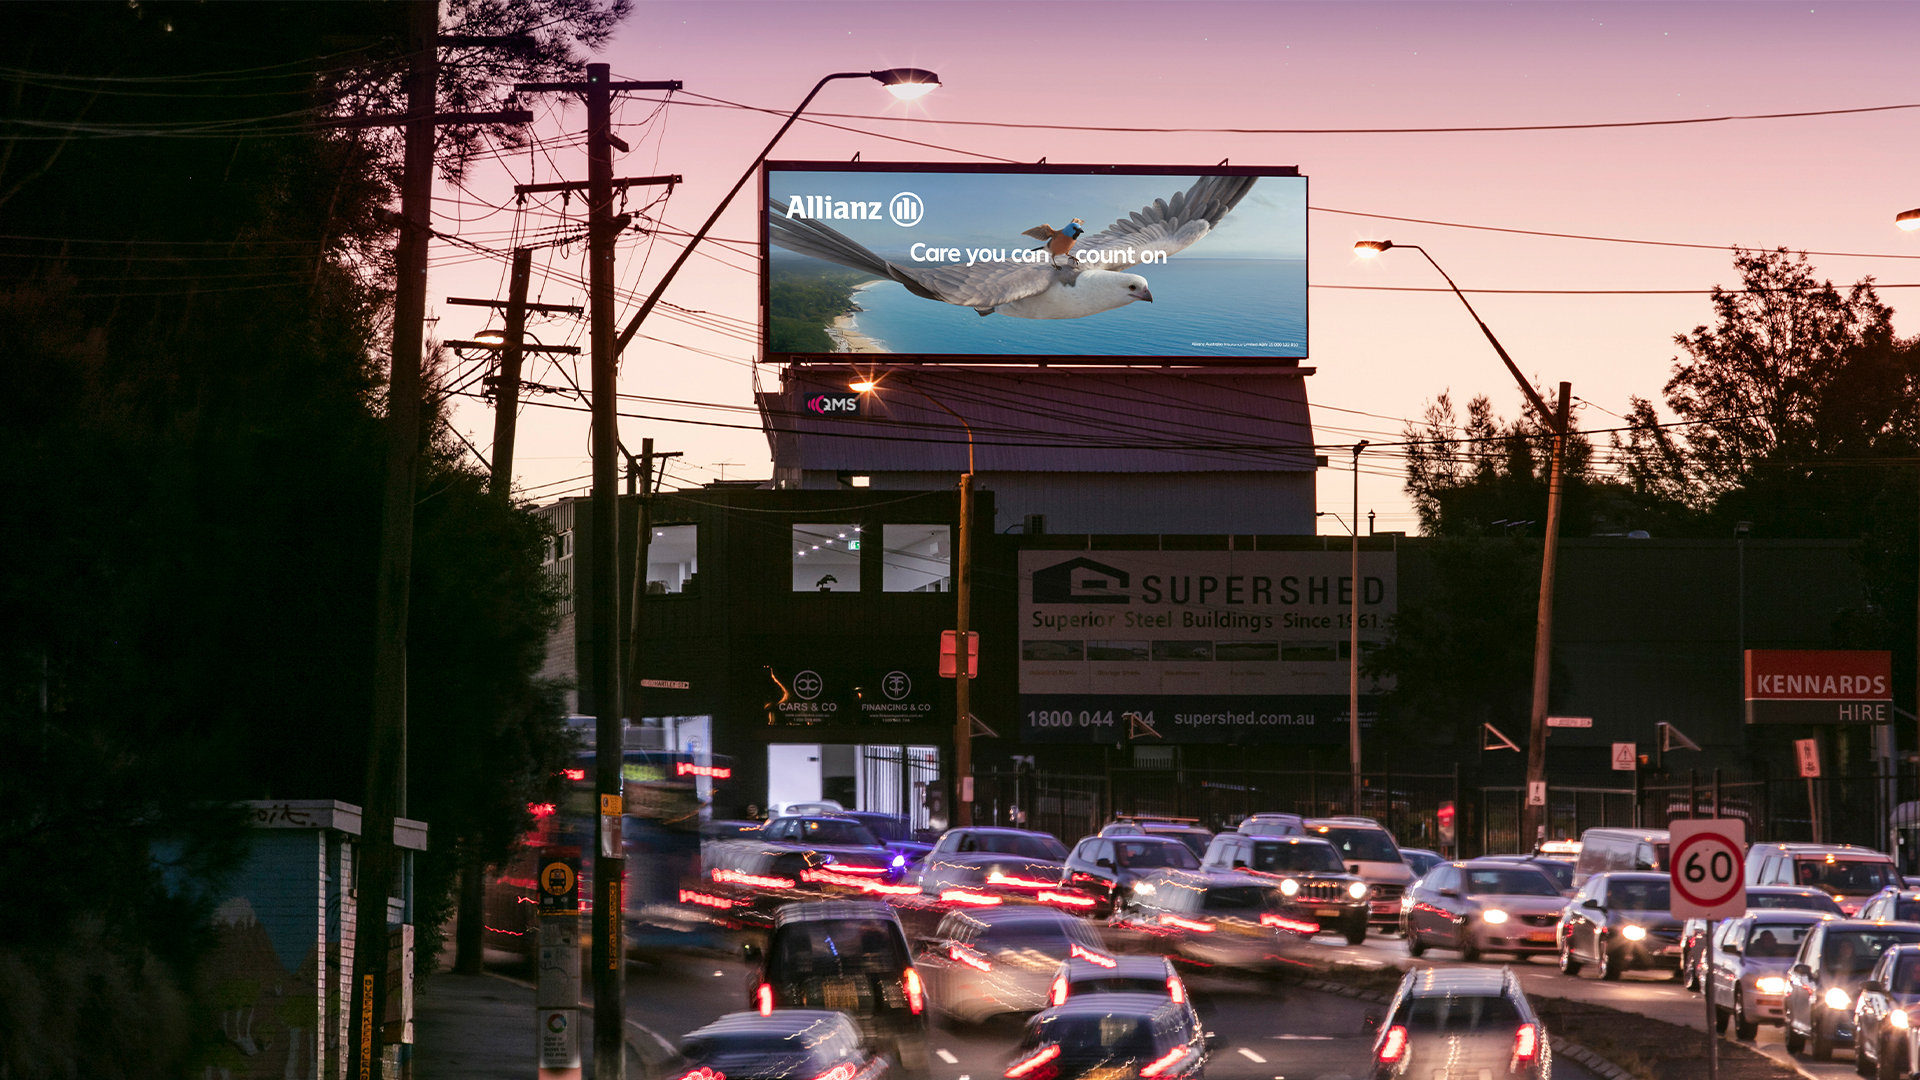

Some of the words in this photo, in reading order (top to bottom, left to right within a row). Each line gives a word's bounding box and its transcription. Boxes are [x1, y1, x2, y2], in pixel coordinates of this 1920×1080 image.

[785, 195, 883, 219] Allianz
[910, 243, 961, 263] Care
[964, 248, 1012, 267] you
[1016, 248, 1050, 263] can
[1075, 246, 1136, 264] count
[1140, 249, 1167, 264] on
[814, 395, 857, 414] QMS
[1141, 575, 1385, 605] SUPERSHED
[1032, 611, 1115, 632] Superior
[1123, 611, 1172, 628] Steel
[1183, 611, 1273, 633] Buildings
[1283, 612, 1331, 628] Since
[1757, 674, 1886, 694] KENNARDS
[778, 703, 808, 712] CARS
[810, 703, 819, 712] &
[821, 703, 837, 712] CO
[861, 703, 909, 712] FINANCING
[910, 704, 917, 712] &
[917, 704, 931, 712] CO
[1839, 704, 1886, 721] HIRE
[1027, 710, 1073, 728] 1800
[1078, 710, 1114, 728] 044
[1174, 710, 1315, 728] supershed.com.au
[1684, 851, 1733, 883] 60
[363, 978, 372, 1013] BUSES
[362, 1016, 371, 1043] KEEP
